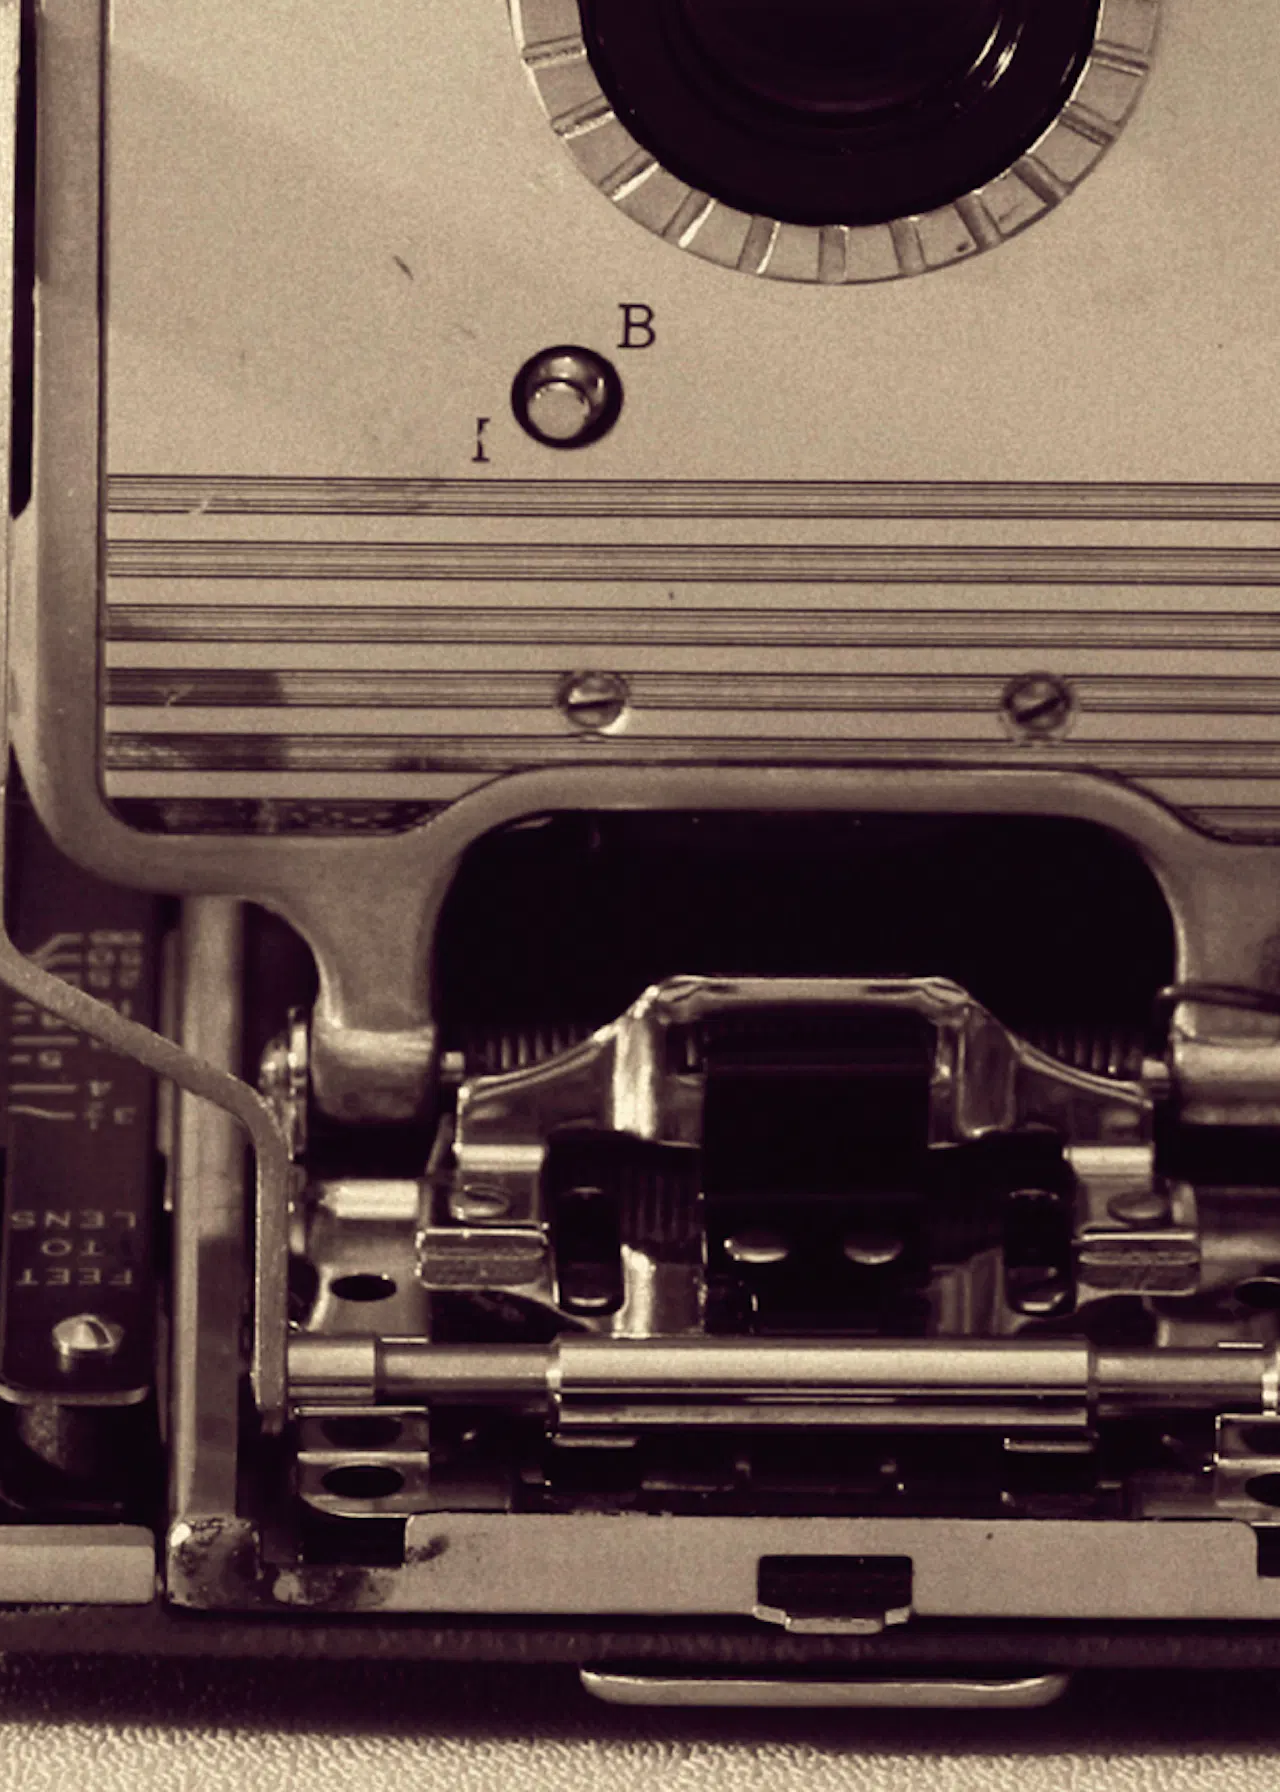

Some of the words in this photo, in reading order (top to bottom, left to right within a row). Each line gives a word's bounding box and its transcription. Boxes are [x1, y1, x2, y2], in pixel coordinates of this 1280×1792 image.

[616, 302, 657, 349] B
[10, 1210, 136, 1230] LENS
[40, 1239, 104, 1256] TO
[16, 1267, 134, 1286] FEET
